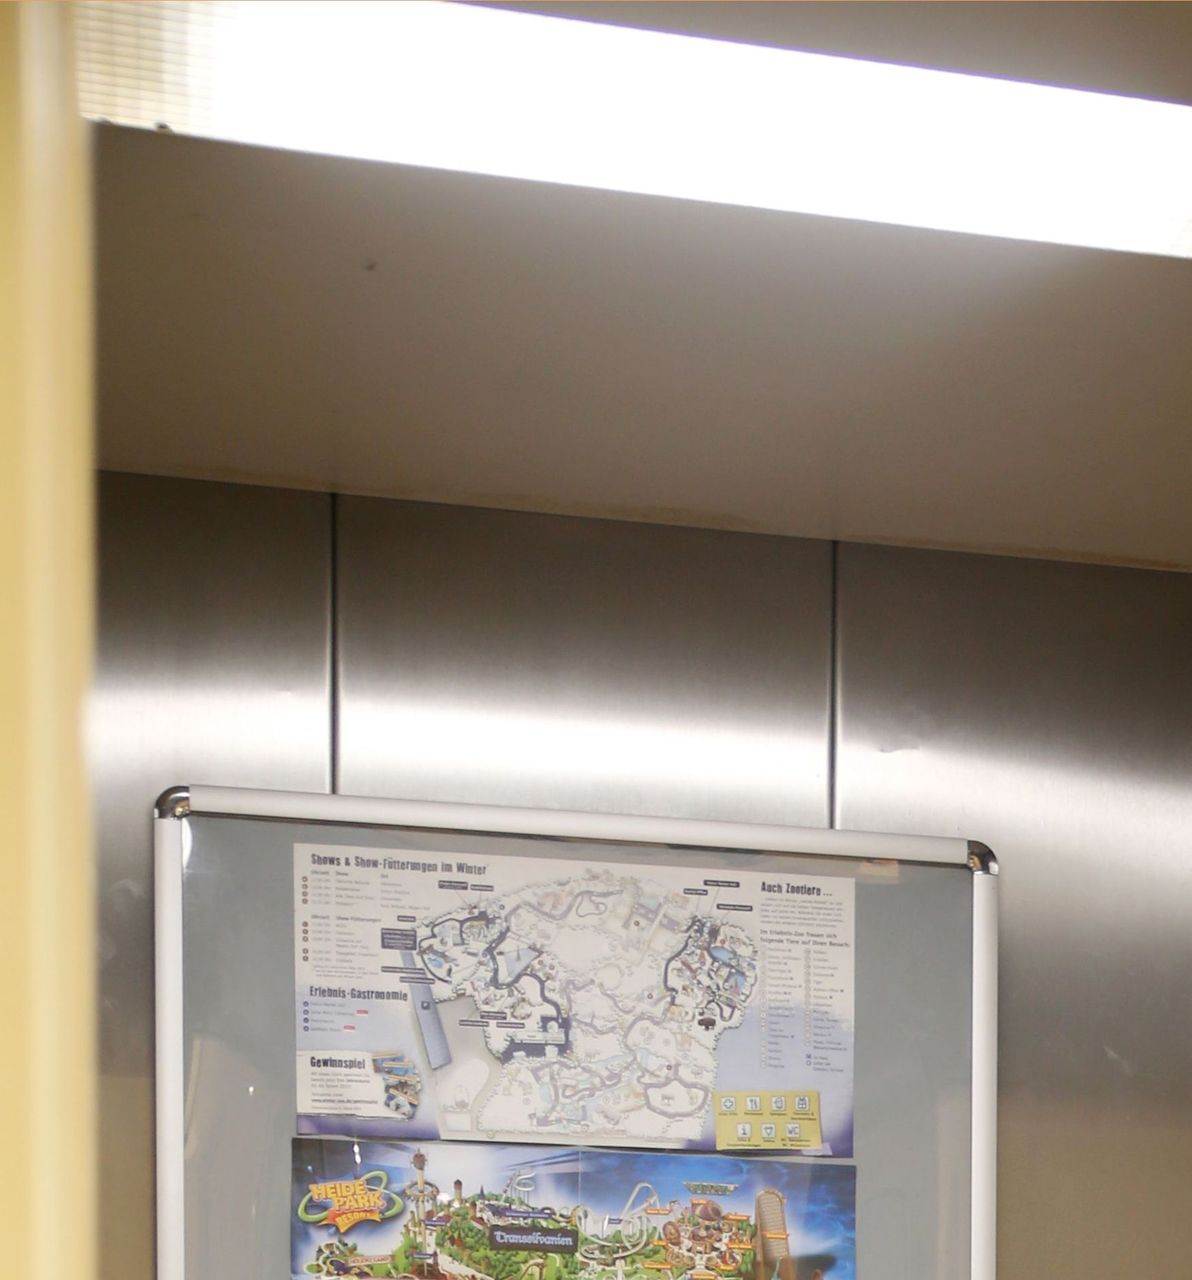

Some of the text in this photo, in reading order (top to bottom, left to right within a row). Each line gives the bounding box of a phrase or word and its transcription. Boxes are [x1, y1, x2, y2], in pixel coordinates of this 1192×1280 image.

[311, 853, 341, 866] Shows
[441, 862, 452, 872] im
[456, 862, 487, 875] Winter
[760, 881, 782, 894] Auch
[309, 986, 408, 1002] Erlebnis-Gastronomie
[310, 1056, 366, 1069] Gewinnspiel
[309, 1180, 365, 1200] HEIDE
[334, 1190, 384, 1210] PARK
